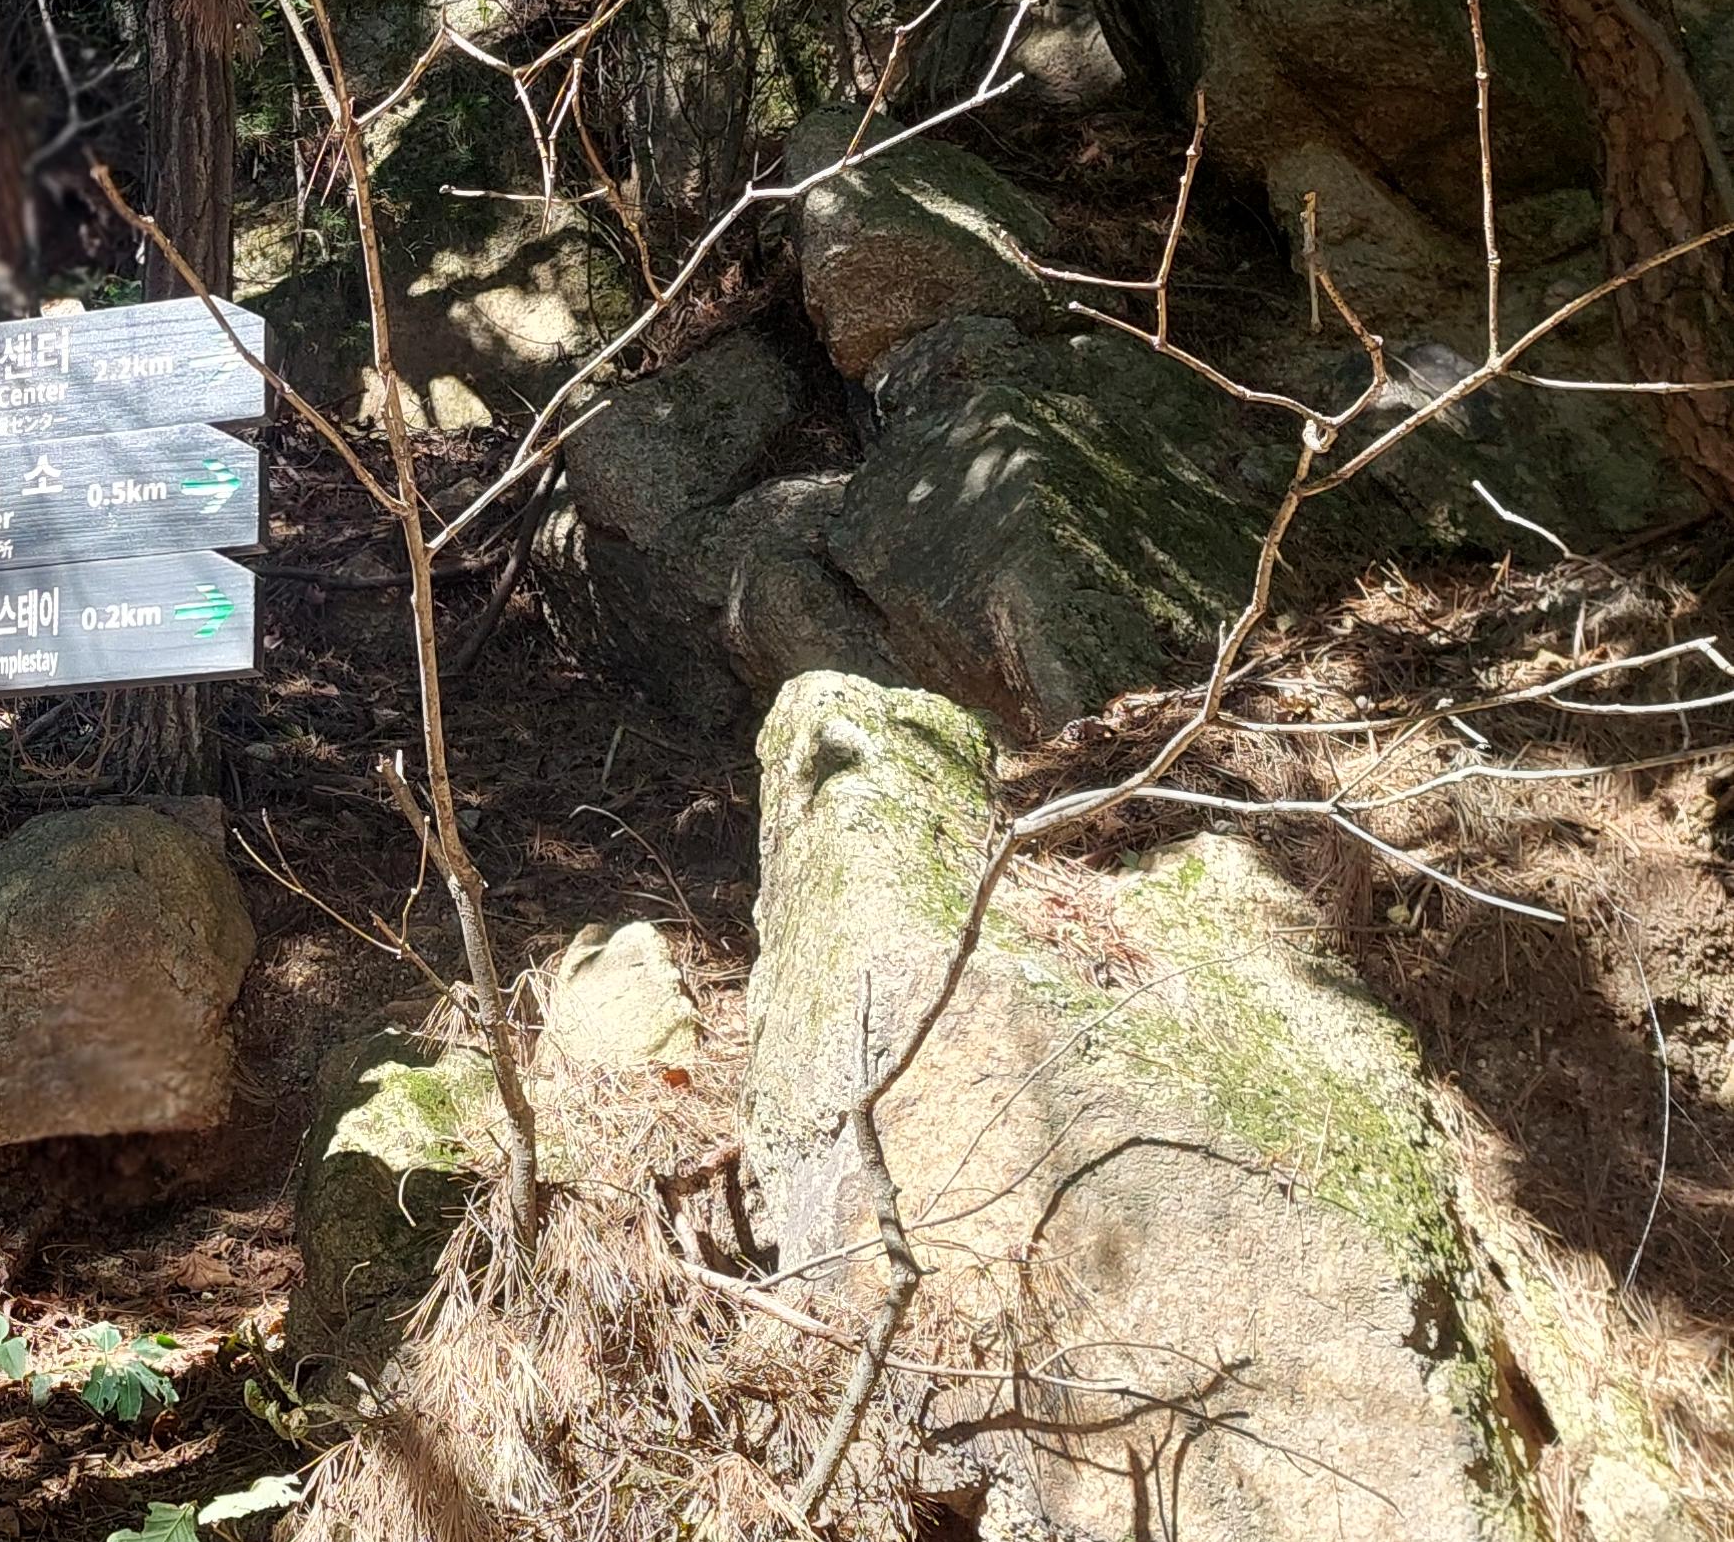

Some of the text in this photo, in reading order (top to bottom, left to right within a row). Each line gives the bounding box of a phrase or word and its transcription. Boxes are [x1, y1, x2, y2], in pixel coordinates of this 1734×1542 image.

[93, 354, 174, 383] 2.2km
[86, 479, 166, 508] 0.5km
[81, 603, 162, 631] 0.2km
